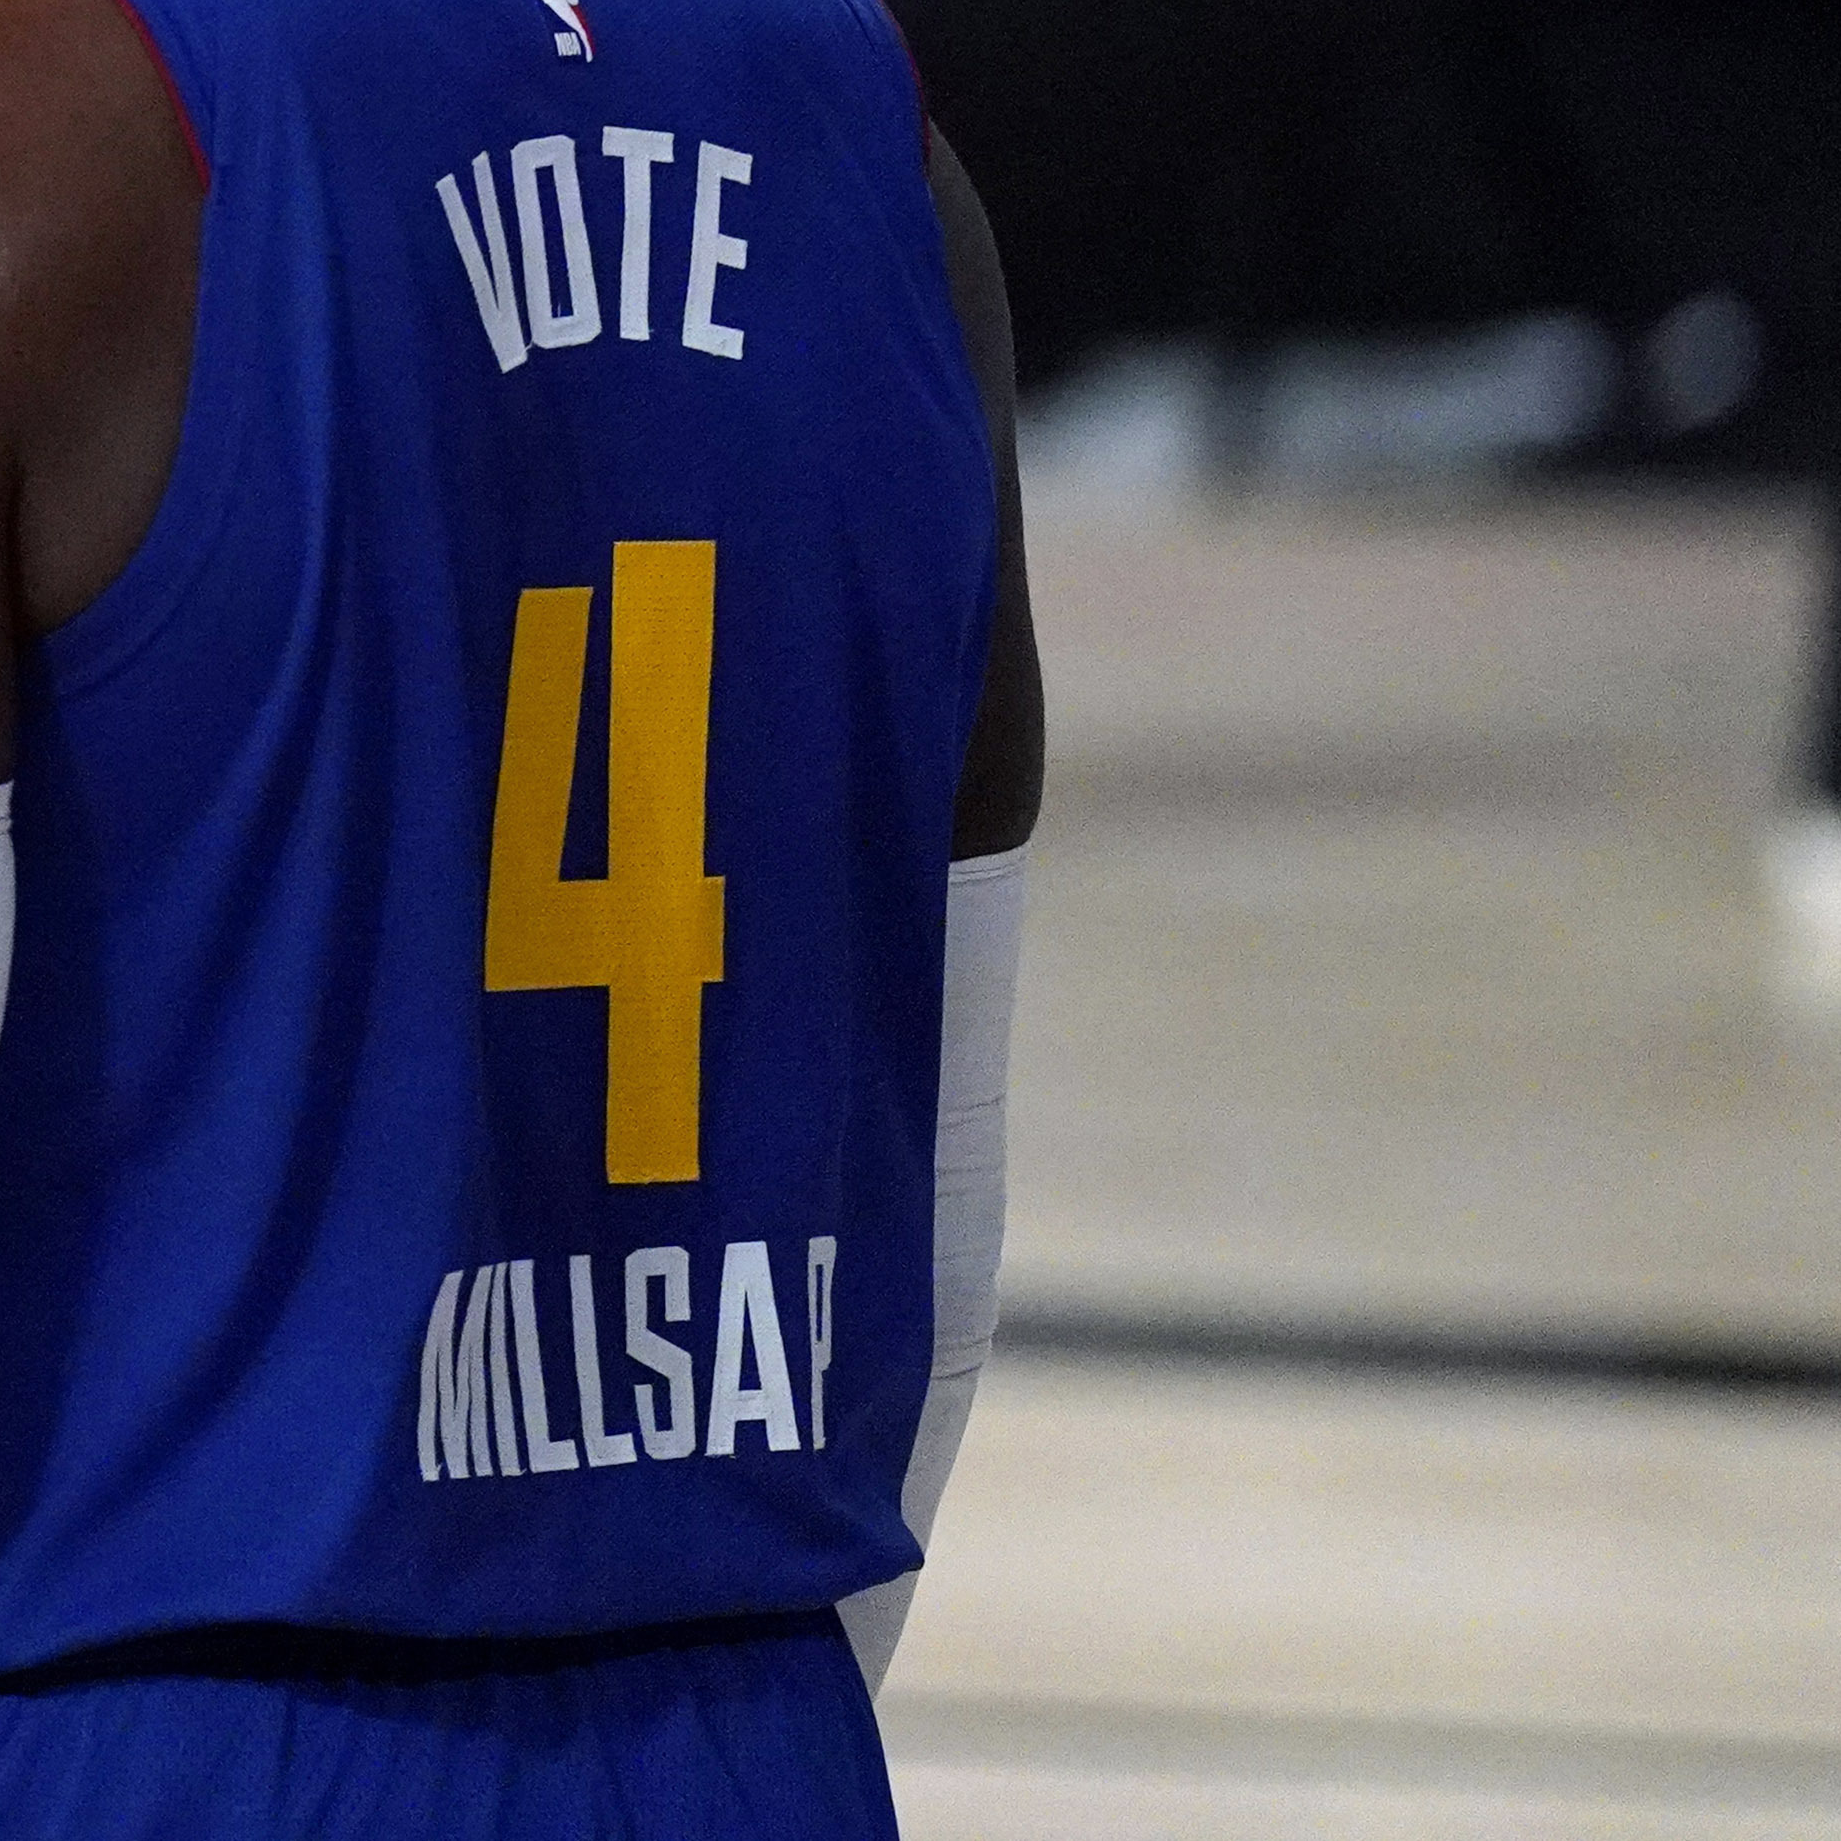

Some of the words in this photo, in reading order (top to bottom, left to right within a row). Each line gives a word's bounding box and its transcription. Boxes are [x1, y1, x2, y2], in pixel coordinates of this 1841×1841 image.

[554, 31, 582, 56] NBA
[435, 125, 753, 374] VOTE
[484, 539, 725, 1184] 4
[418, 1235, 837, 1482] MILLSAP
